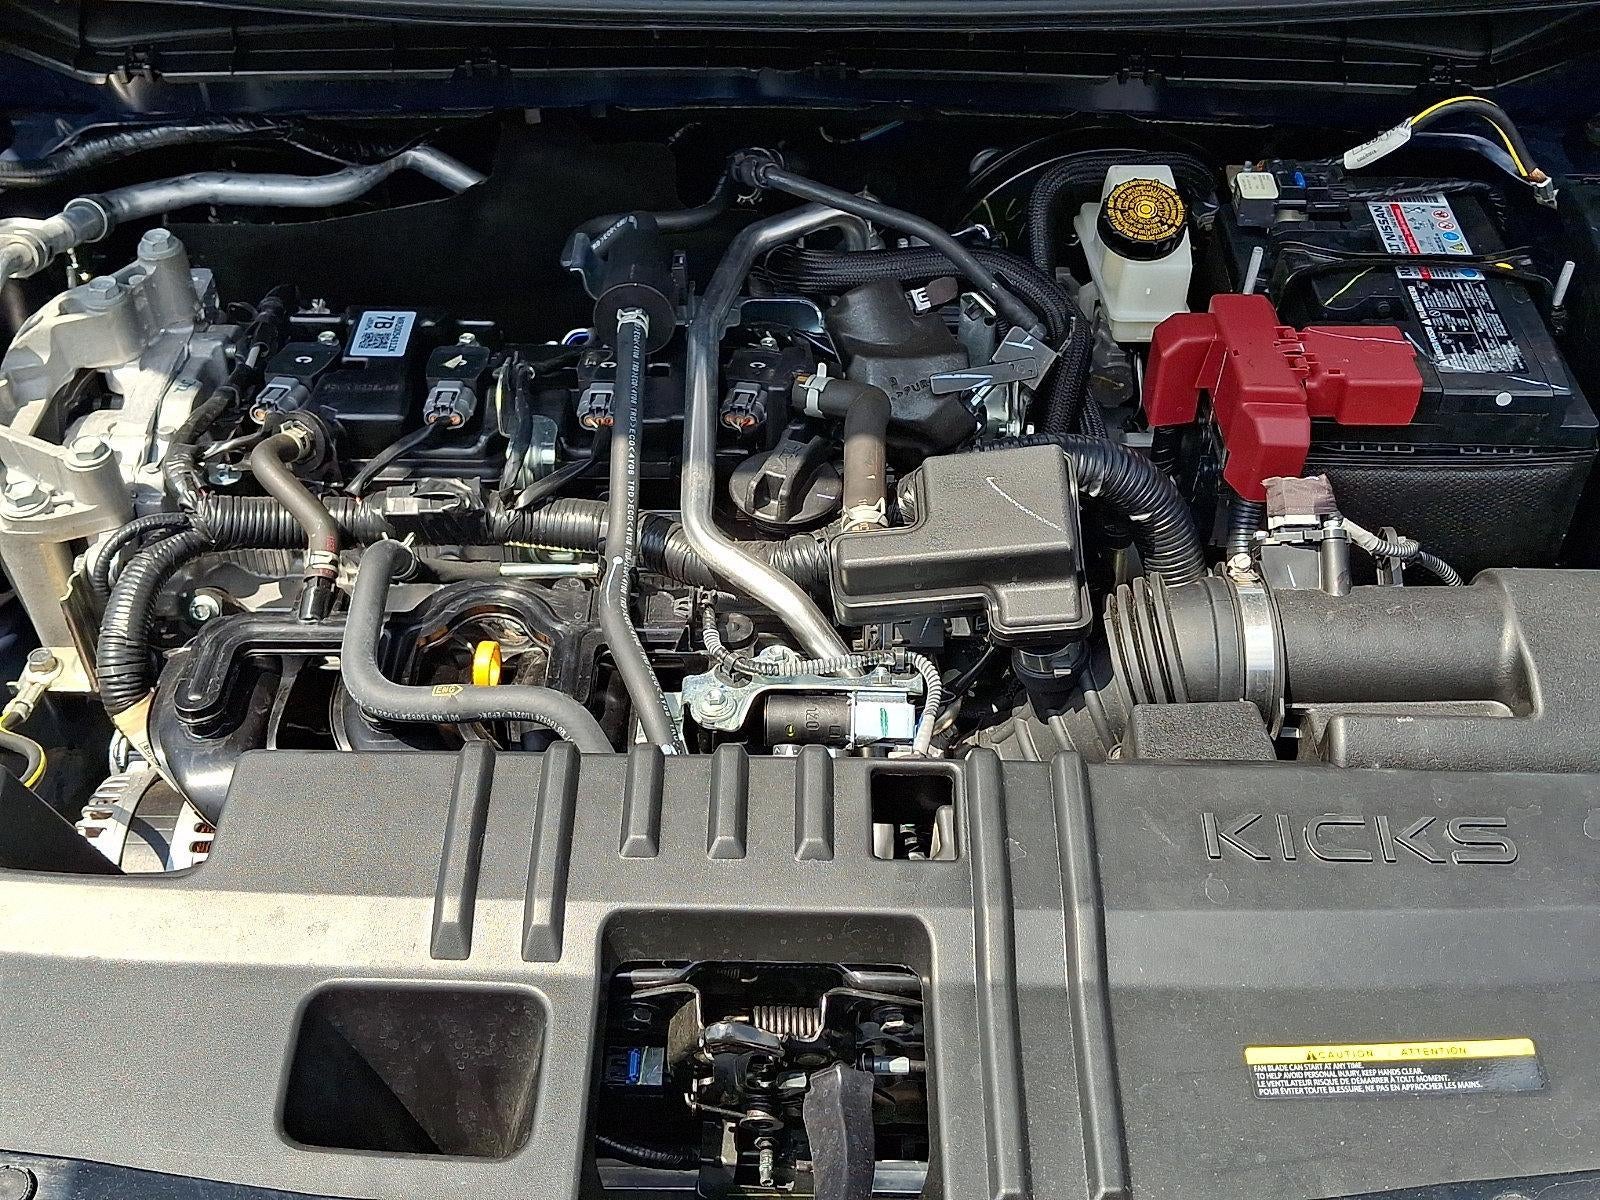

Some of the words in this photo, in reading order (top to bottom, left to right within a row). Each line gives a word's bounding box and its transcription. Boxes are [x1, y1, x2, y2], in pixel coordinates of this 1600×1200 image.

[1372, 205, 1396, 241] NISSAN
[1201, 812, 1519, 865] KICKS
[1319, 1050, 1374, 1060] CAUTION
[1401, 1046, 1468, 1057] ATTENTION
[1253, 1064, 1267, 1072] FAN
[1267, 1064, 1289, 1072] BLADE
[1289, 1063, 1304, 1071] CAN
[1304, 1063, 1324, 1071] START
[1324, 1062, 1333, 1070] AT
[1333, 1062, 1347, 1070] ANY
[1255, 1072, 1266, 1080] TO
[1266, 1072, 1283, 1080] HELP
[1283, 1071, 1304, 1079] AVOID
[1304, 1070, 1337, 1078] PERSONAL
[1362, 1069, 1377, 1077] KEEP
[1378, 1068, 1401, 1076] HANDS
[1401, 1067, 1424, 1075] CLEAR.
[1257, 1080, 1266, 1088] LE
[1266, 1079, 1313, 1088] VENTILATEUR
[1313, 1078, 1339, 1087] RISQUE
[1350, 1076, 1389, 1085] DÉMARRER
[1397, 1075, 1416, 1083] TOUT
[1416, 1074, 1450, 1083] MOMENT.
[1280, 1086, 1304, 1095] ÉVITER
[1304, 1086, 1328, 1094] TOUTE
[1365, 1084, 1378, 1092] NE
[1378, 1084, 1390, 1092] PAS
[1401, 1082, 1443, 1091] APPROCHER
[1444, 1081, 1457, 1089] LES
[1457, 1081, 1483, 1089] MAINS.
